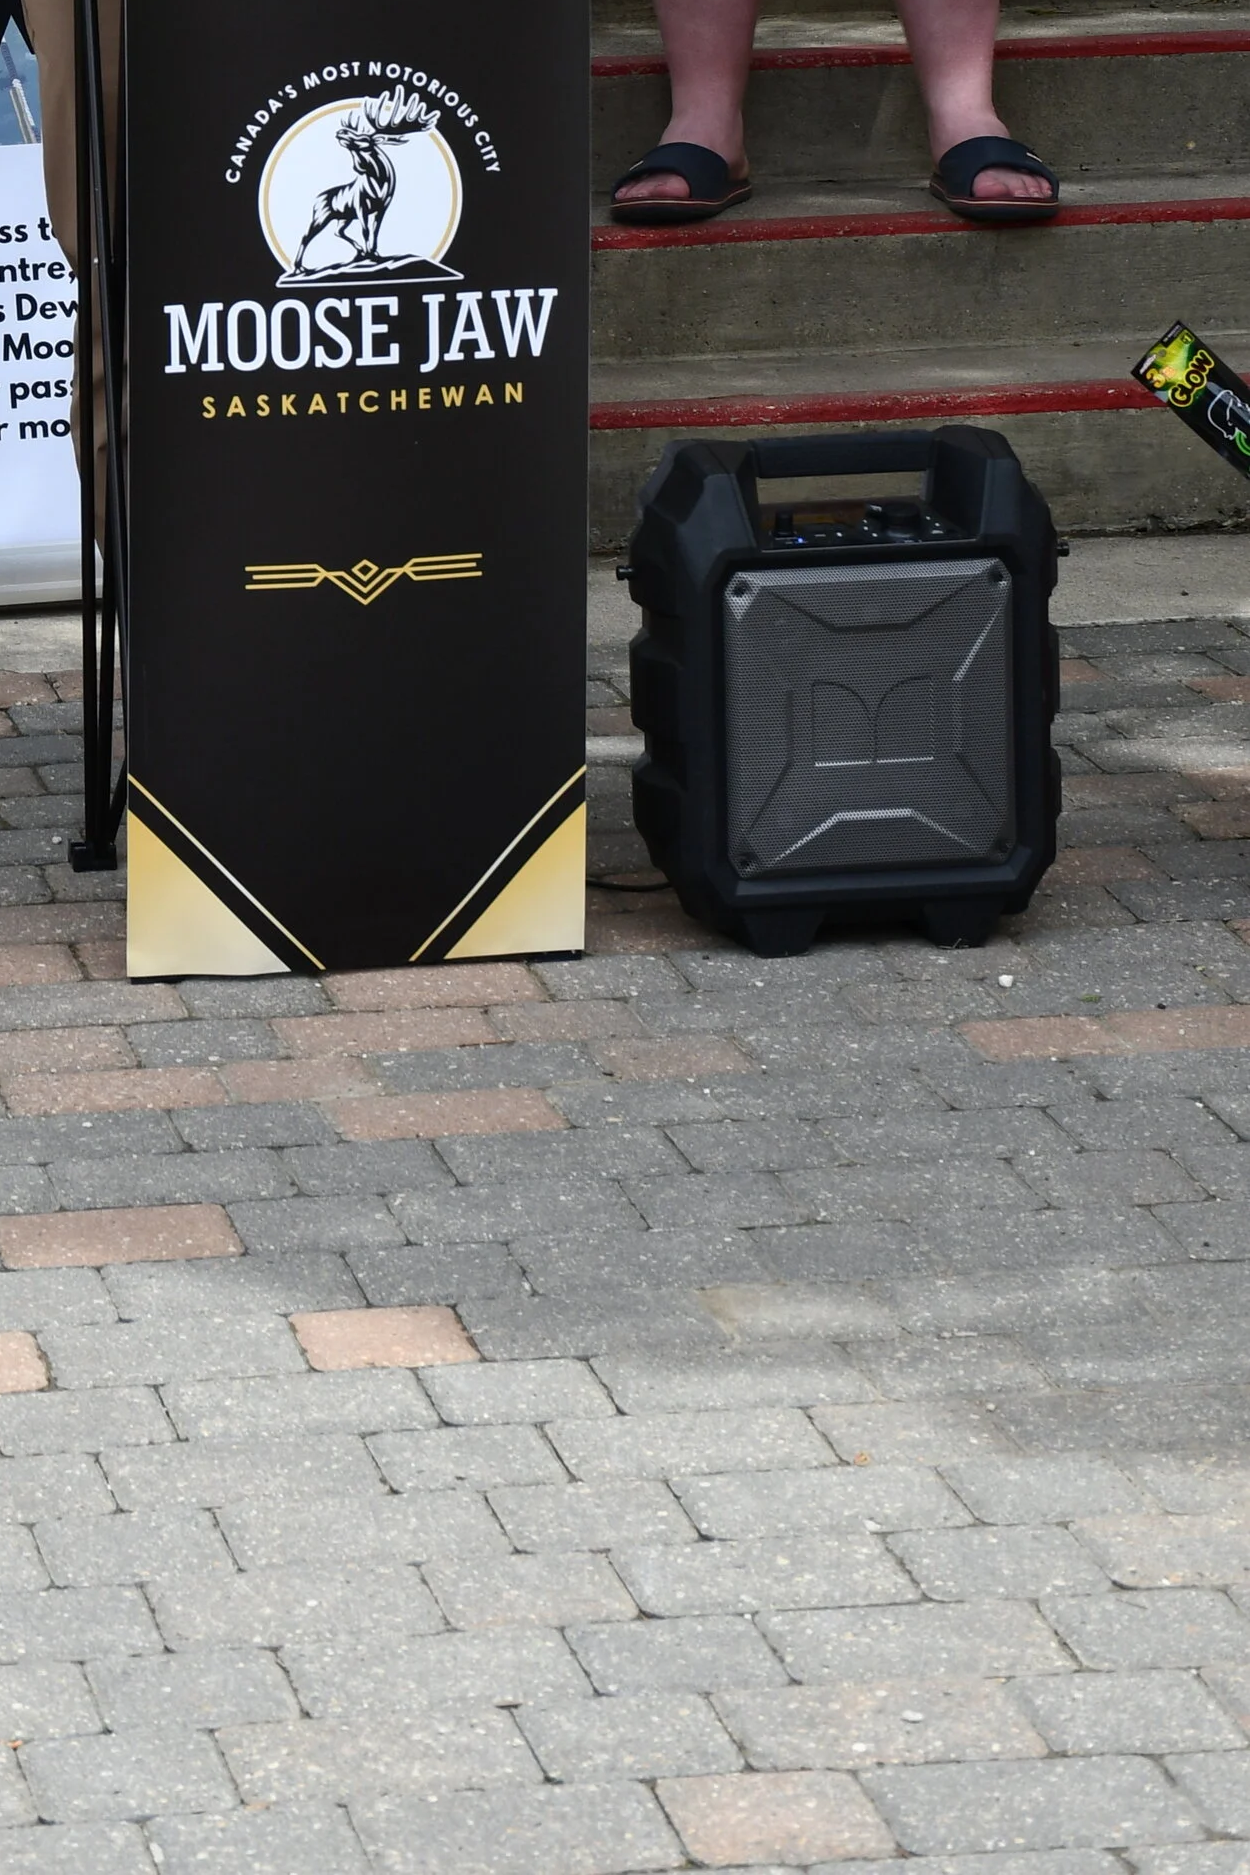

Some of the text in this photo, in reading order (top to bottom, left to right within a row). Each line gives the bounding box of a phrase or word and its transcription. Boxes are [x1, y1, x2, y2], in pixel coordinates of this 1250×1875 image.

[225, 61, 502, 184] CANADA'S MOST NOTORIOUS CITY
[15, 293, 78, 322] Dew
[2, 332, 75, 362] Moo
[163, 288, 558, 374] MOOSE JAW
[9, 378, 74, 409] pas
[1168, 349, 1215, 408] GLOW
[202, 382, 524, 419] SASKATCHEWAN
[19, 418, 71, 440] mo
